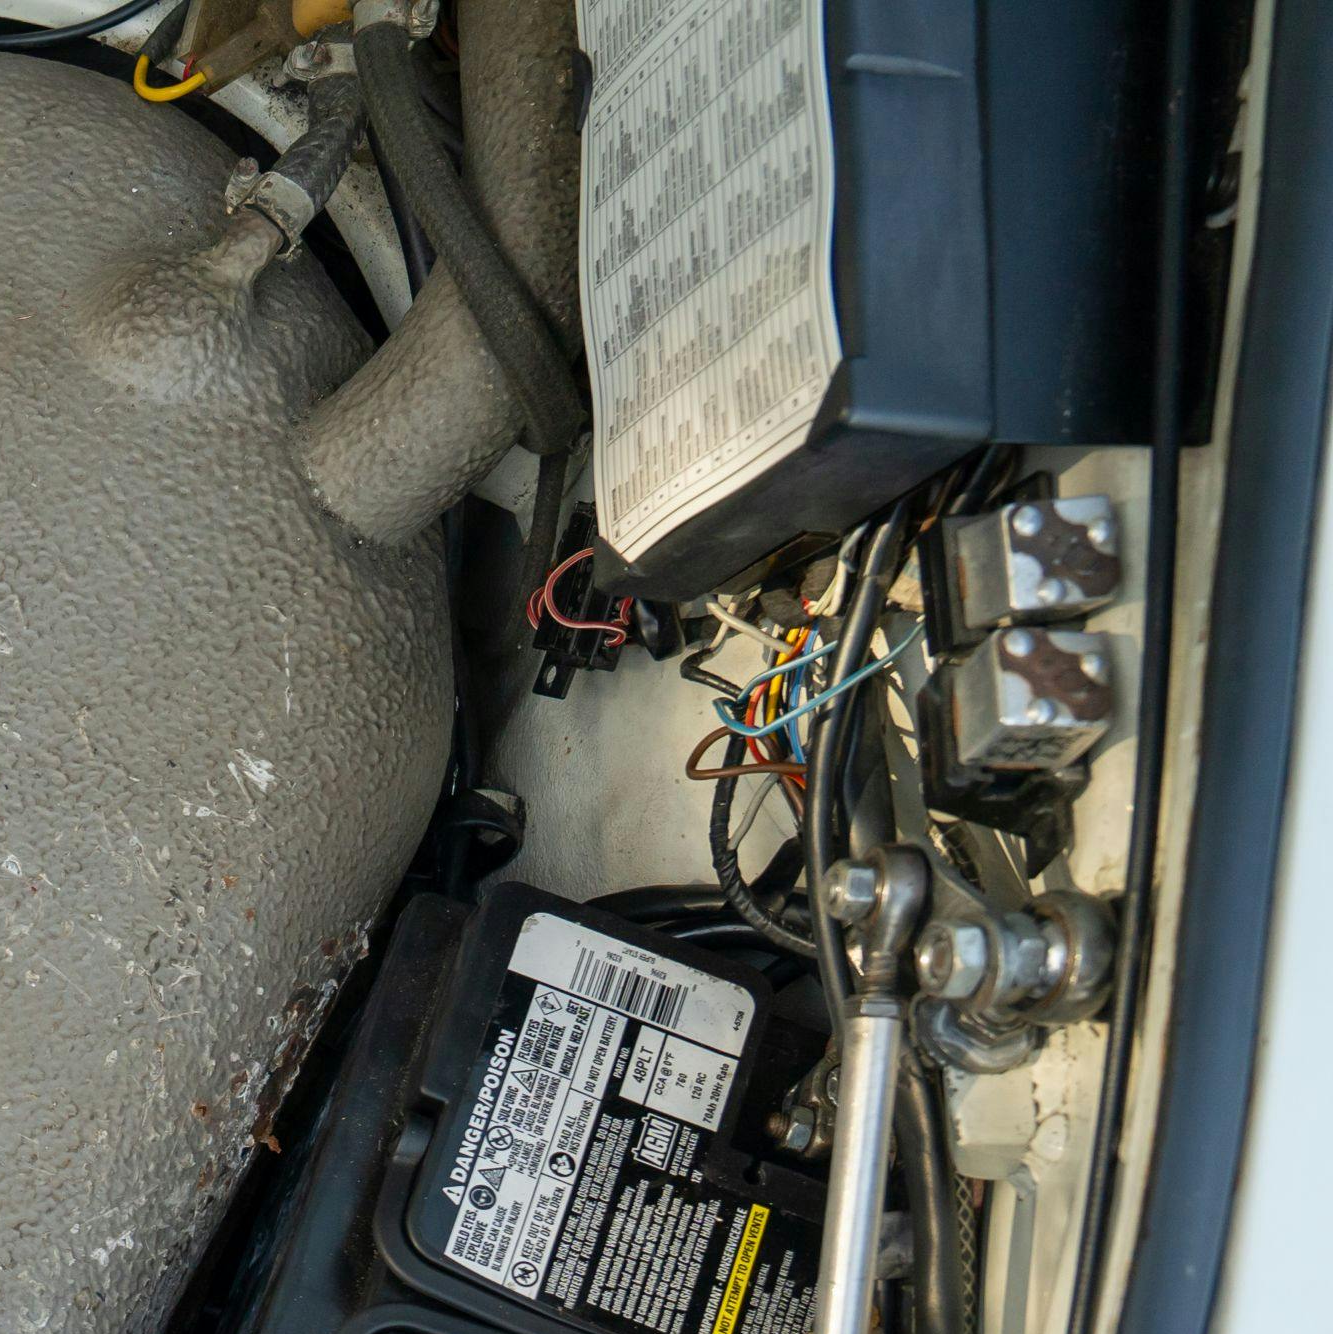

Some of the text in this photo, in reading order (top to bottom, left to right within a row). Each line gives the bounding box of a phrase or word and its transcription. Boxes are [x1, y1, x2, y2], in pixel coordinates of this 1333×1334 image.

[565, 998, 580, 1015] GET
[517, 1018, 540, 1060] FLUSH EYES
[529, 1017, 554, 1064] IMMEDIATELY
[541, 1025, 566, 1068] WITH WATER.
[558, 1005, 592, 1076] MEDICAL HELP FAST.
[583, 1014, 617, 1093] DO NOT OPEN BATTERY.
[612, 1047, 629, 1078] PART NO.
[632, 1045, 653, 1083] 48PLT
[653, 1077, 667, 1095] CCA
[660, 1066, 672, 1076] @
[674, 1072, 687, 1087] 760
[449, 1028, 516, 1183] DANGER/POISON
[497, 1085, 519, 1122] SULFURIC
[522, 1073, 550, 1131] CAUSE BLINDNESS
[533, 1076, 561, 1135] OR SEVERE BURNS.
[690, 1071, 707, 1099] 120 RC
[702, 1063, 729, 1123] 70Ah 20Hr Rate
[510, 1093, 531, 1127] ACID CAN
[567, 1099, 594, 1155] INSTRUCTIONS.
[556, 1115, 577, 1150] READ ALL
[640, 1118, 673, 1166] AGM
[668, 1125, 691, 1175] BATTERY MUST
[678, 1166, 688, 1176] BE
[690, 1169, 703, 1183] 12V
[451, 1209, 478, 1257] SHIELD EYES.
[464, 1220, 488, 1262] EXPLOSIVE
[477, 1205, 508, 1266] GASES CAN CAUSE
[520, 1193, 550, 1259] KEEP OUT OF THE
[531, 1186, 565, 1264] REACH OF CHILDREN.
[715, 1207, 747, 1282] NONSERVICEABLE
[747, 1211, 764, 1238] VENTS.
[491, 1234, 511, 1272] BLINDNESS
[503, 1224, 514, 1235] OR
[735, 1263, 748, 1275] TO
[740, 1239, 755, 1263] OPEN
[724, 1275, 744, 1315] ATTEMPT
[718, 1315, 731, 1334] NOT
